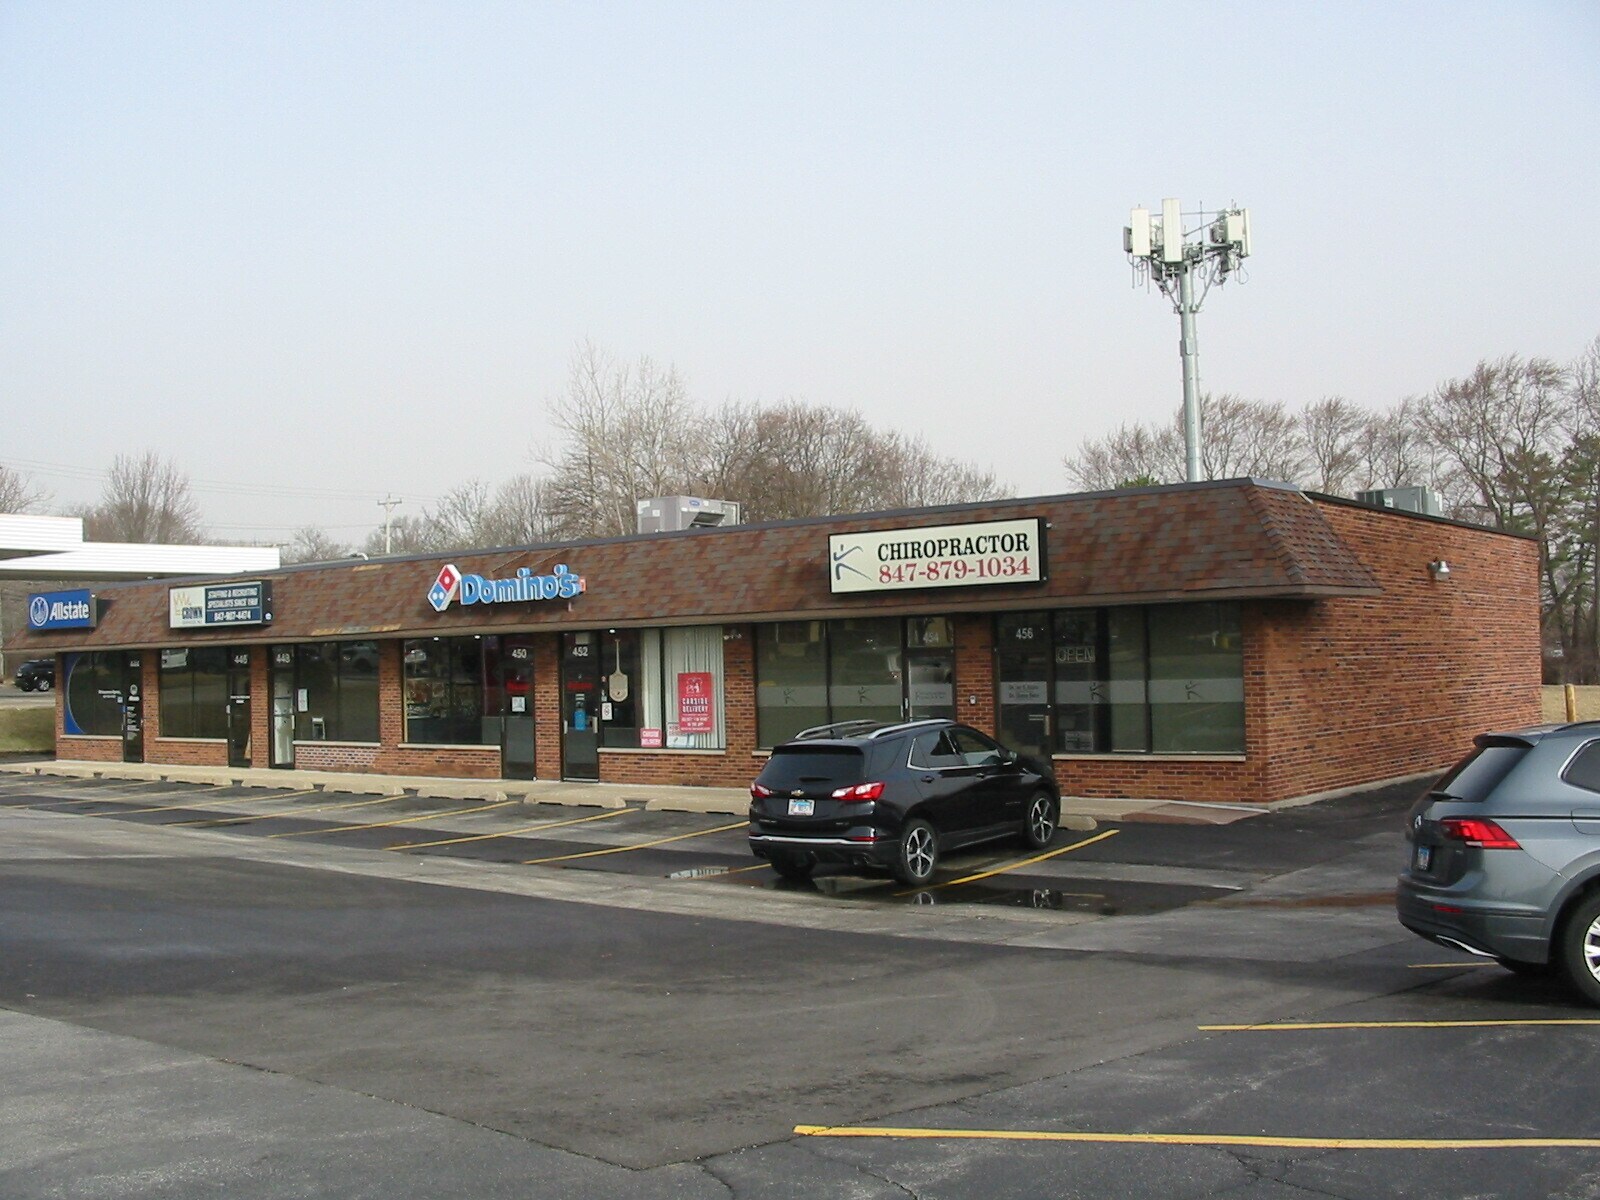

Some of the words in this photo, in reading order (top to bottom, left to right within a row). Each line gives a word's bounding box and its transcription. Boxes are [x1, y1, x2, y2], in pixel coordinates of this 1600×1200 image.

[877, 532, 1030, 561] CHIROPRACTOR
[879, 556, 1031, 584] 847-879-1034
[460, 563, 581, 606] Domino's
[49, 600, 90, 621] Allstate
[1015, 627, 1034, 639] 456
[511, 648, 527, 659] 450
[572, 646, 589, 657] 452
[1056, 646, 1094, 662] OPEN
[682, 697, 708, 705] CARSIDE
[682, 705, 708, 713] DELIVERY
